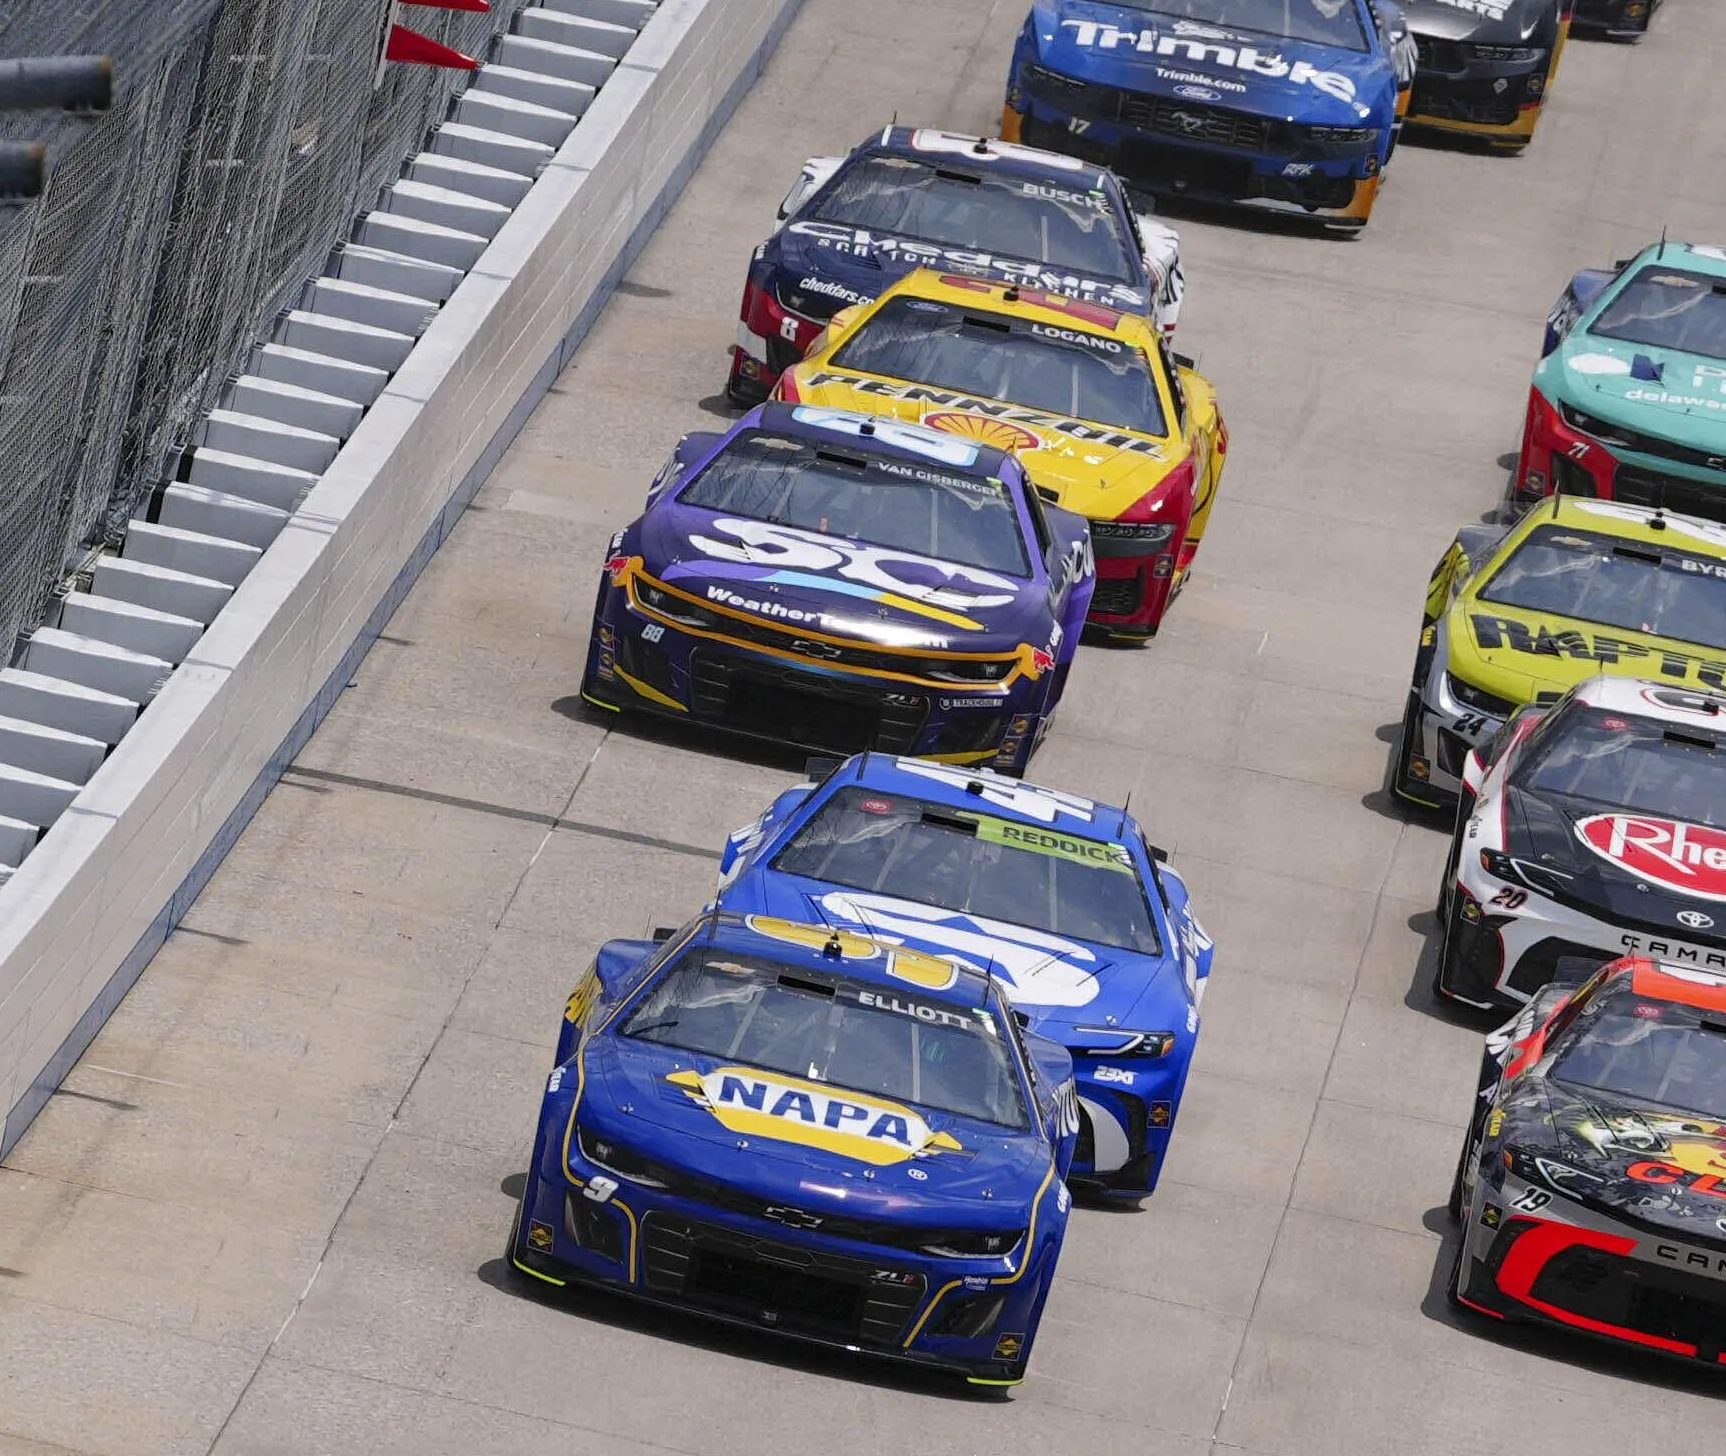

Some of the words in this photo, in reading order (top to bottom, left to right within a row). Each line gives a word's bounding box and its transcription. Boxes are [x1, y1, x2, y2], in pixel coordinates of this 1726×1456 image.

[1061, 18, 1358, 104] Trimble
[1154, 67, 1247, 94] Trimble.com
[1068, 117, 1090, 136] 17
[1023, 182, 1109, 211] BUSCH
[799, 275, 875, 307] cheddars.co
[780, 316, 799, 342] 8
[1031, 323, 1123, 354] LOGANO
[805, 372, 1170, 462] PENNZOIL
[878, 461, 913, 477] VAN
[915, 469, 999, 497] GISBERGE
[640, 623, 666, 646] 88
[1452, 712, 1489, 736] 24
[1003, 826, 1130, 864] REDDICK
[1489, 885, 1529, 910] 20
[858, 990, 972, 1031] ELLIOTT
[1093, 1064, 1137, 1086] 23XI
[718, 1076, 912, 1146] NAPA
[584, 1176, 619, 1202] 9
[1511, 1186, 1553, 1212] 19
